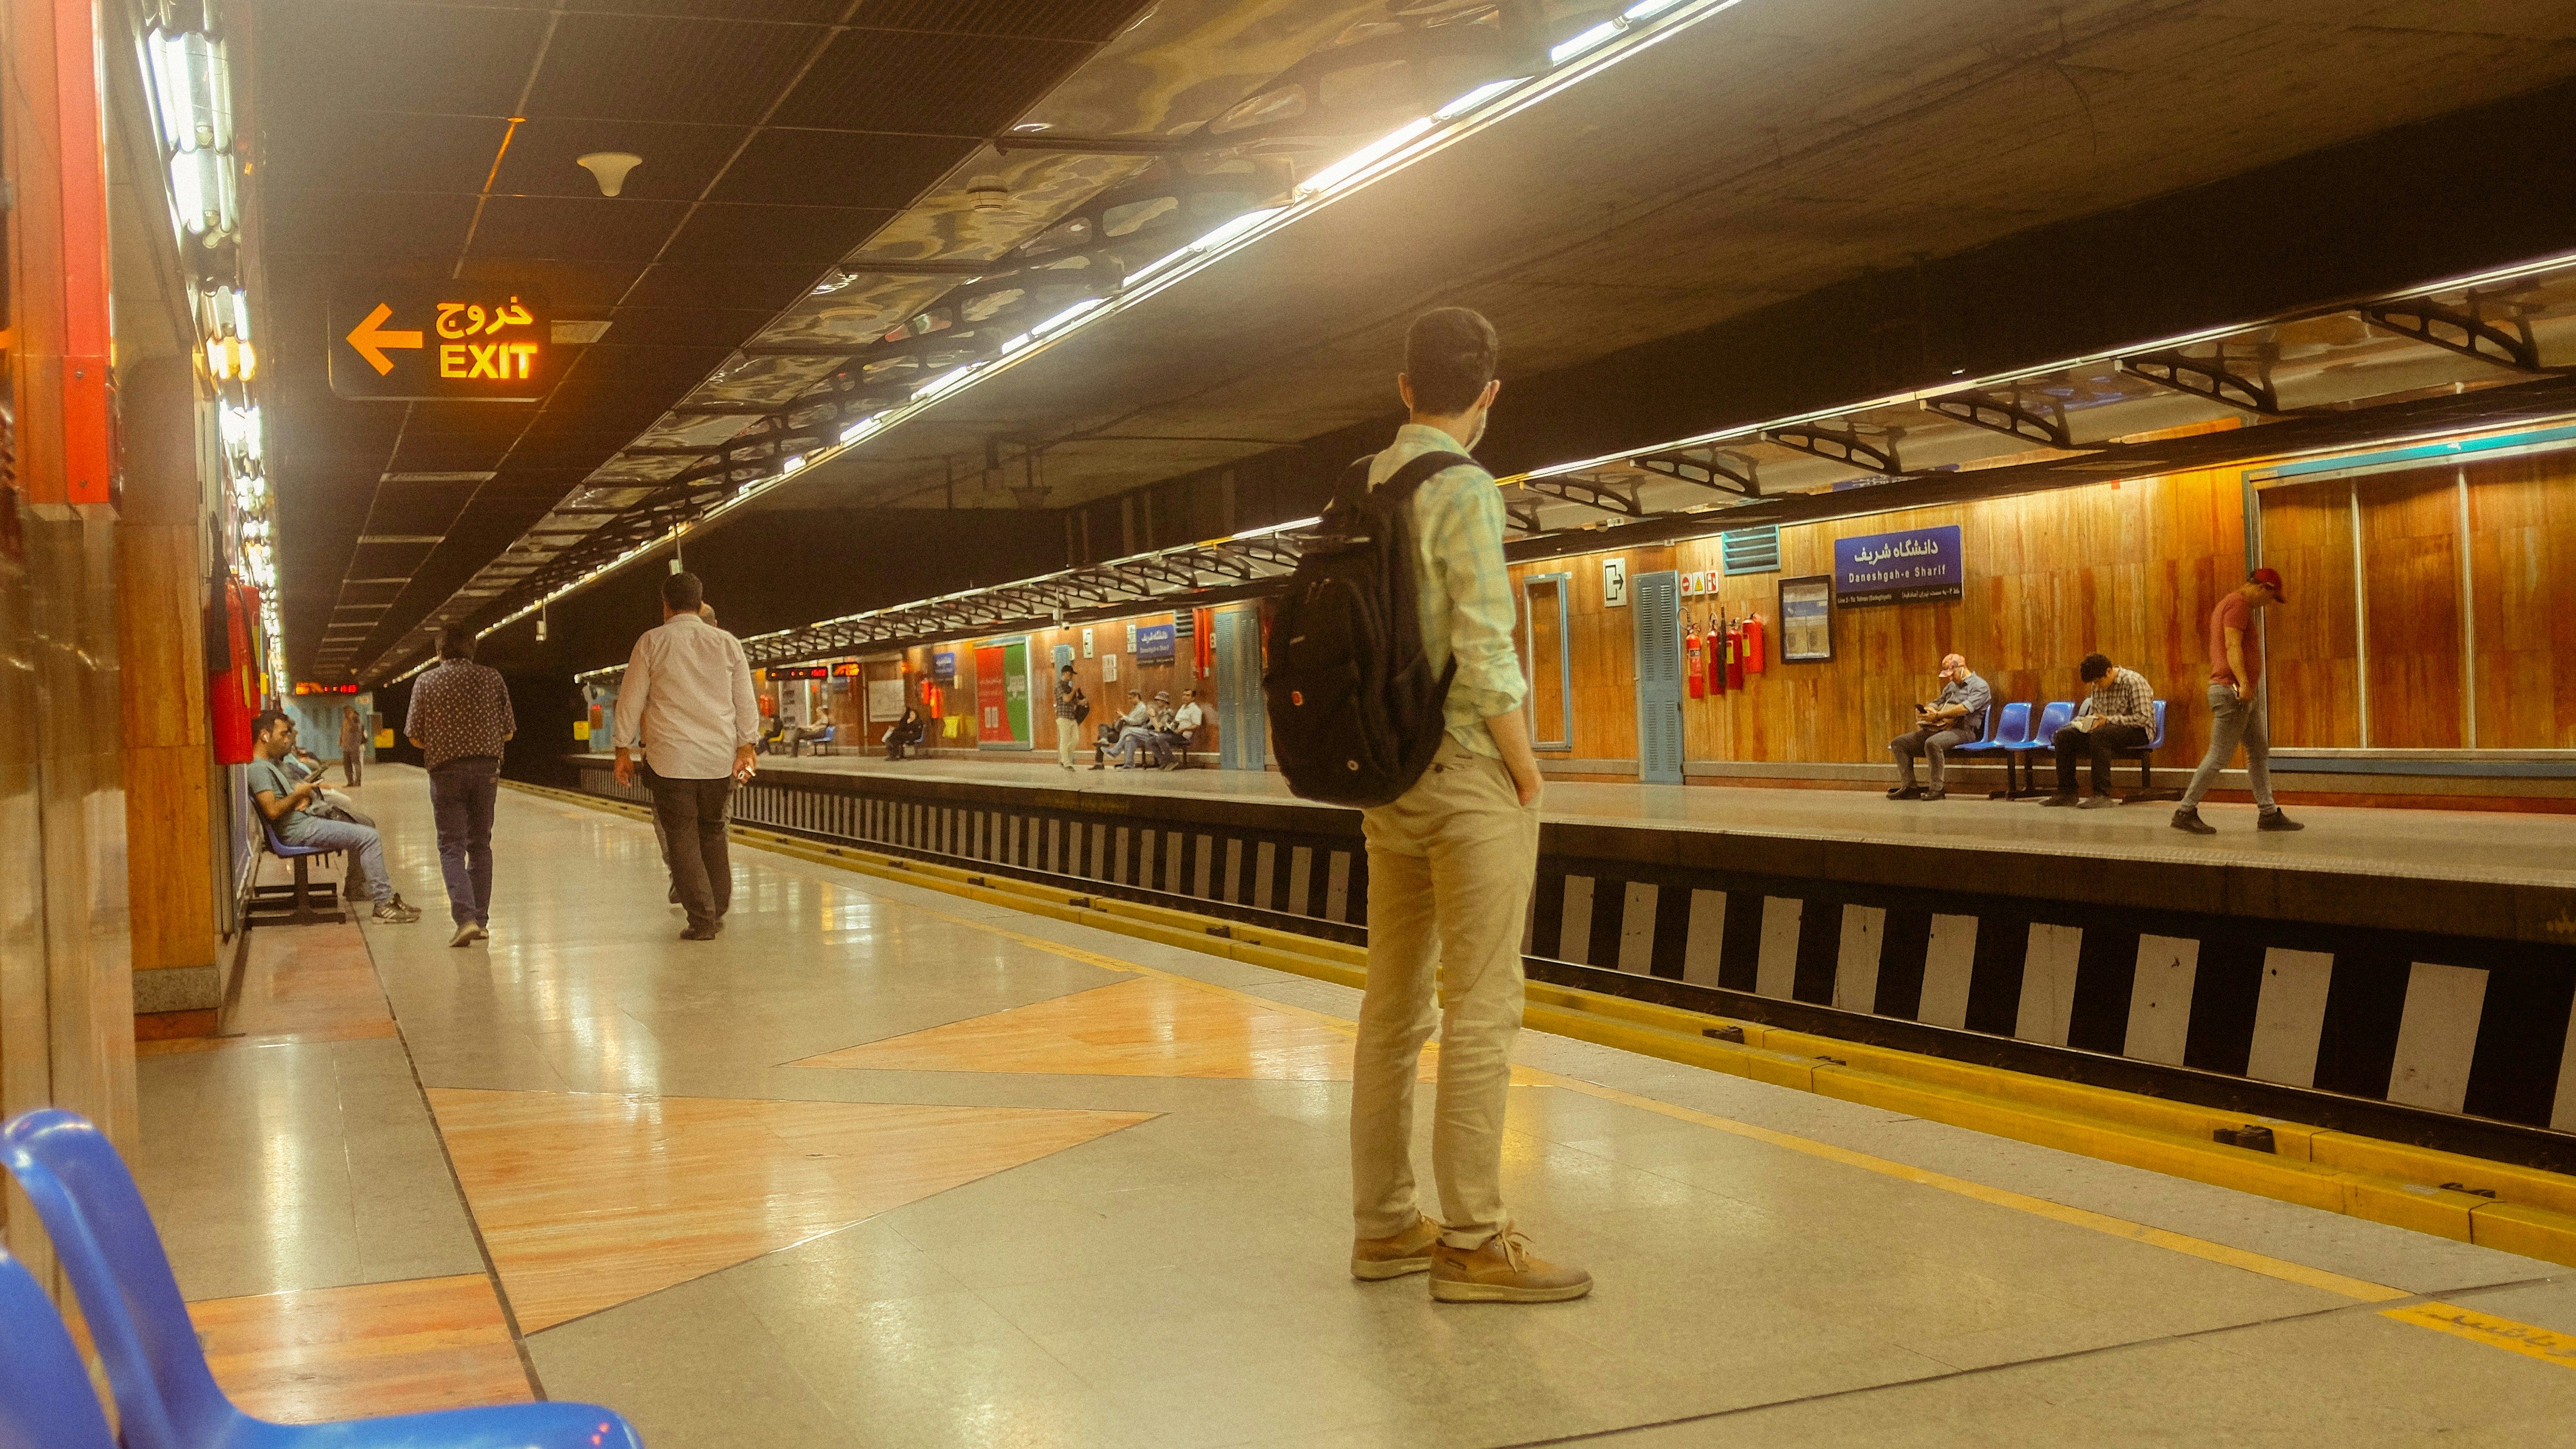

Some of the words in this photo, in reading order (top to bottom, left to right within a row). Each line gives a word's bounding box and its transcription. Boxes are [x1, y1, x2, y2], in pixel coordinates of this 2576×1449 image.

[436, 296, 533, 339] خروج
[439, 344, 537, 378] EXIT
[1854, 543, 1891, 565] شریف
[1893, 539, 1939, 558] دانشگاه
[1849, 569, 1910, 583] Daneshgah-e
[1914, 564, 1946, 577] Sharif
